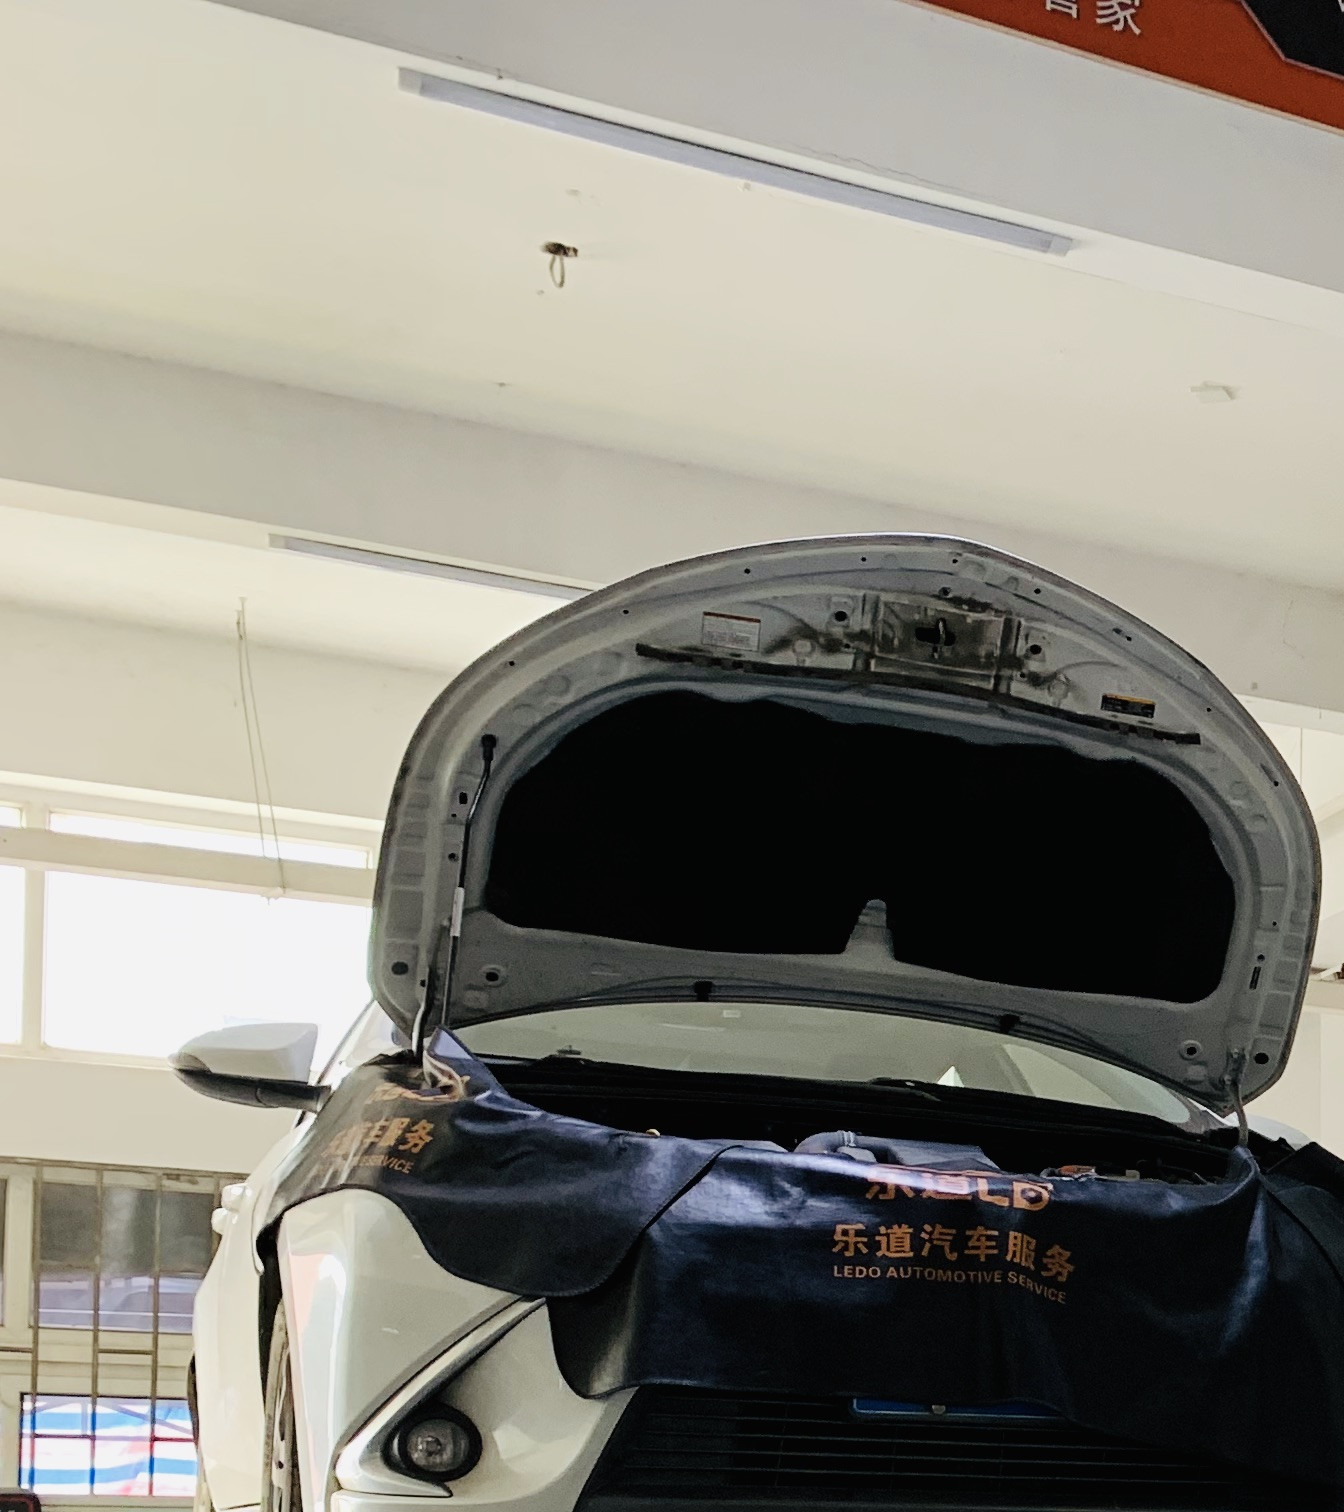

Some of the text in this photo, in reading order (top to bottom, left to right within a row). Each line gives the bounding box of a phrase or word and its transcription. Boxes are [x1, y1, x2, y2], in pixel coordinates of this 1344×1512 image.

[832, 1223, 1075, 1282] 乐道汽车服务
[833, 1265, 1067, 1304] LEDO AUTOMOTIVE SERVICE
